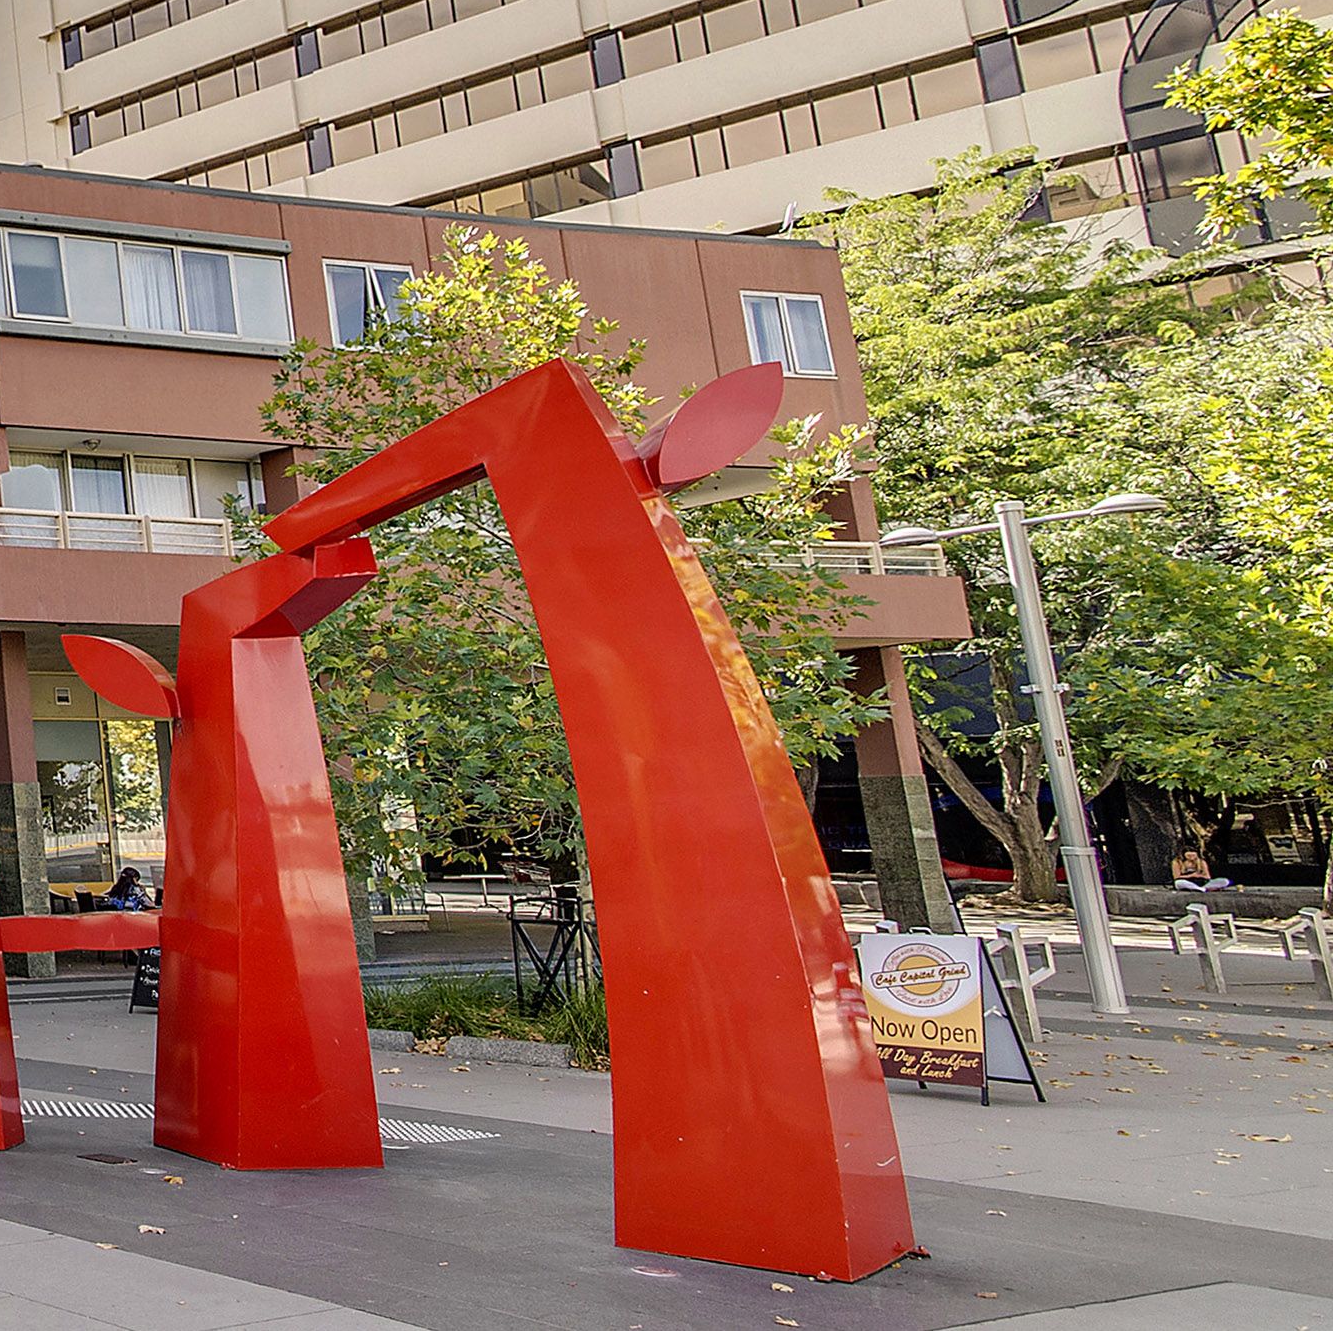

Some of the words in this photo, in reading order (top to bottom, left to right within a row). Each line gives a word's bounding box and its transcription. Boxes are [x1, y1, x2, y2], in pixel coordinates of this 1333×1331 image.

[899, 970, 935, 984] Capital
[938, 966, 966, 980] Grind
[871, 1016, 915, 1038] Now
[921, 1019, 977, 1045] Open
[893, 1049, 916, 1067] Day
[920, 1051, 980, 1070] Breakfast
[900, 1065, 920, 1075] and
[921, 1065, 953, 1078] Lunch
